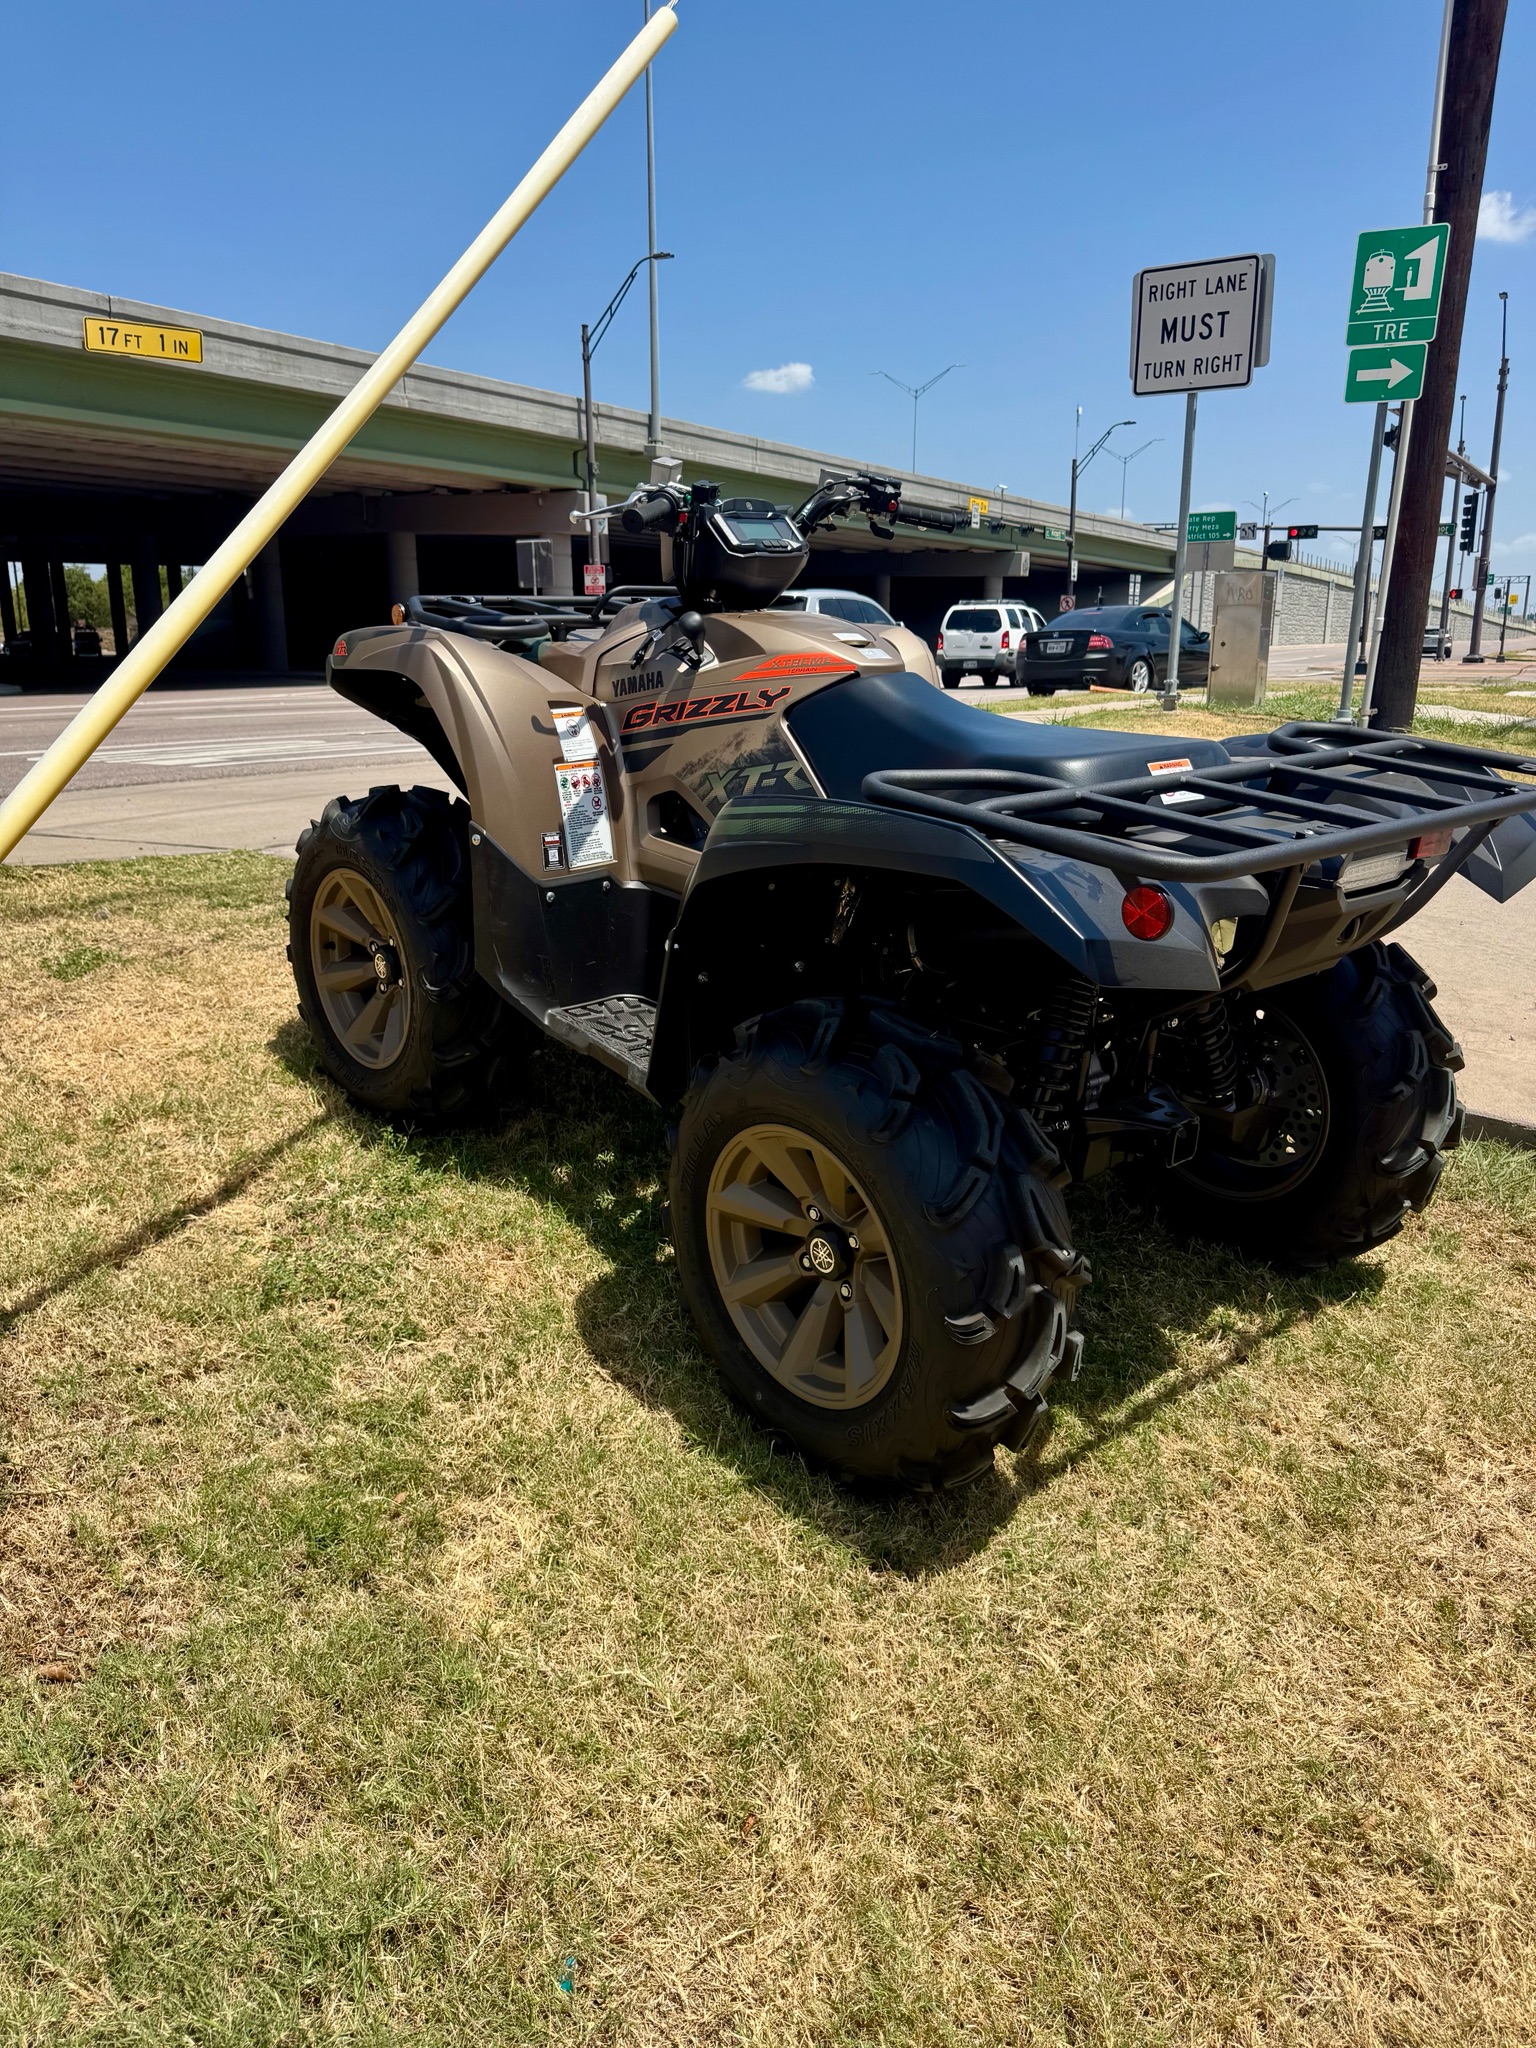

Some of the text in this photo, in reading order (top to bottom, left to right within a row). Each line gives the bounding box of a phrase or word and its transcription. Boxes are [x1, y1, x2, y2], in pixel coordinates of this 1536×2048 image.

[1148, 272, 1248, 303] RIGHT LANE
[98, 326, 188, 355] 17 FT 1 IN
[1160, 310, 1230, 345] MUST
[1373, 322, 1410, 341] TRE
[1144, 353, 1243, 380] TURN RIGHT
[1189, 515, 1216, 523] ate Rep
[1189, 525, 1200, 533] rry
[1208, 531, 1220, 539] 105
[769, 656, 833, 670] XTREME
[611, 670, 664, 698] YAMAHA
[619, 685, 793, 733] GRIZZLY
